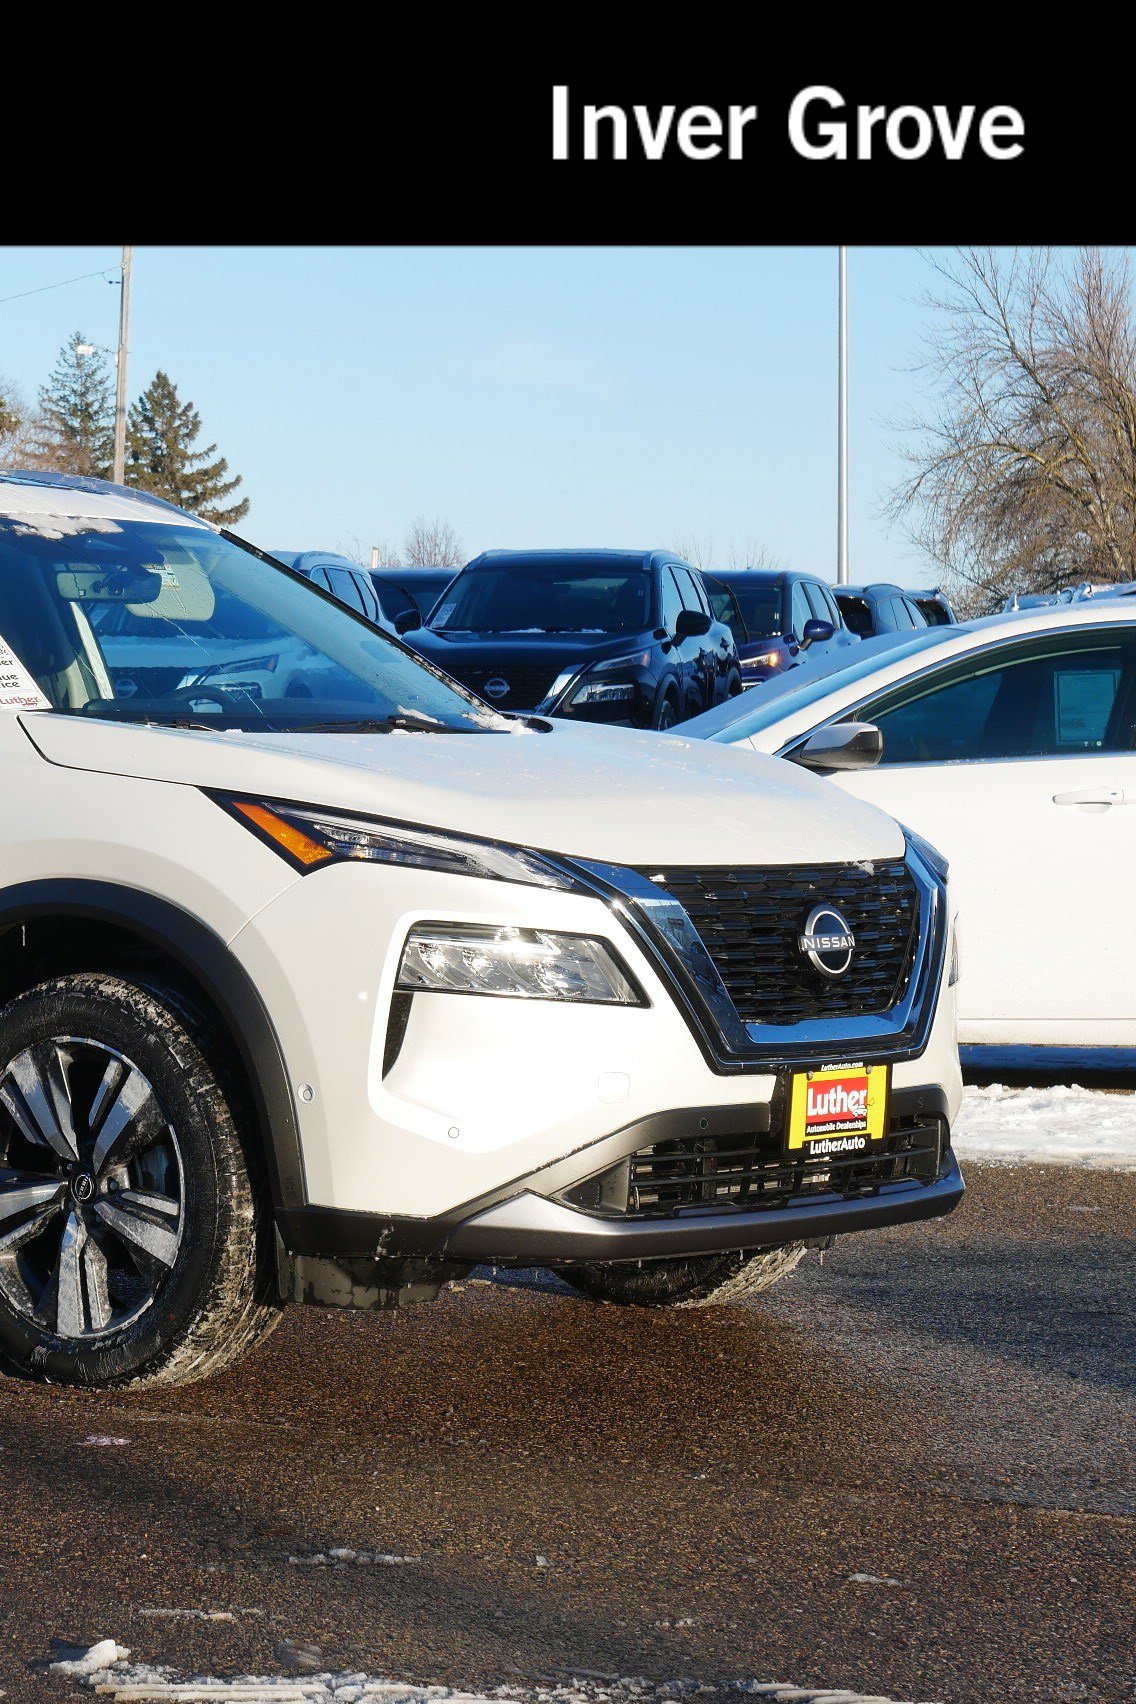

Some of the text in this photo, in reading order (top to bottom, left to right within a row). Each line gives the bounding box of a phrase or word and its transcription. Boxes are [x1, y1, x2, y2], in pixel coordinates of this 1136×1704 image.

[803, 936, 856, 949] NISSAN
[821, 1062, 864, 1072] LutherAuto.com
[807, 1085, 867, 1116] Luther
[806, 1120, 867, 1134] Automobile Dealerships
[810, 1136, 866, 1155] LutherAuto
